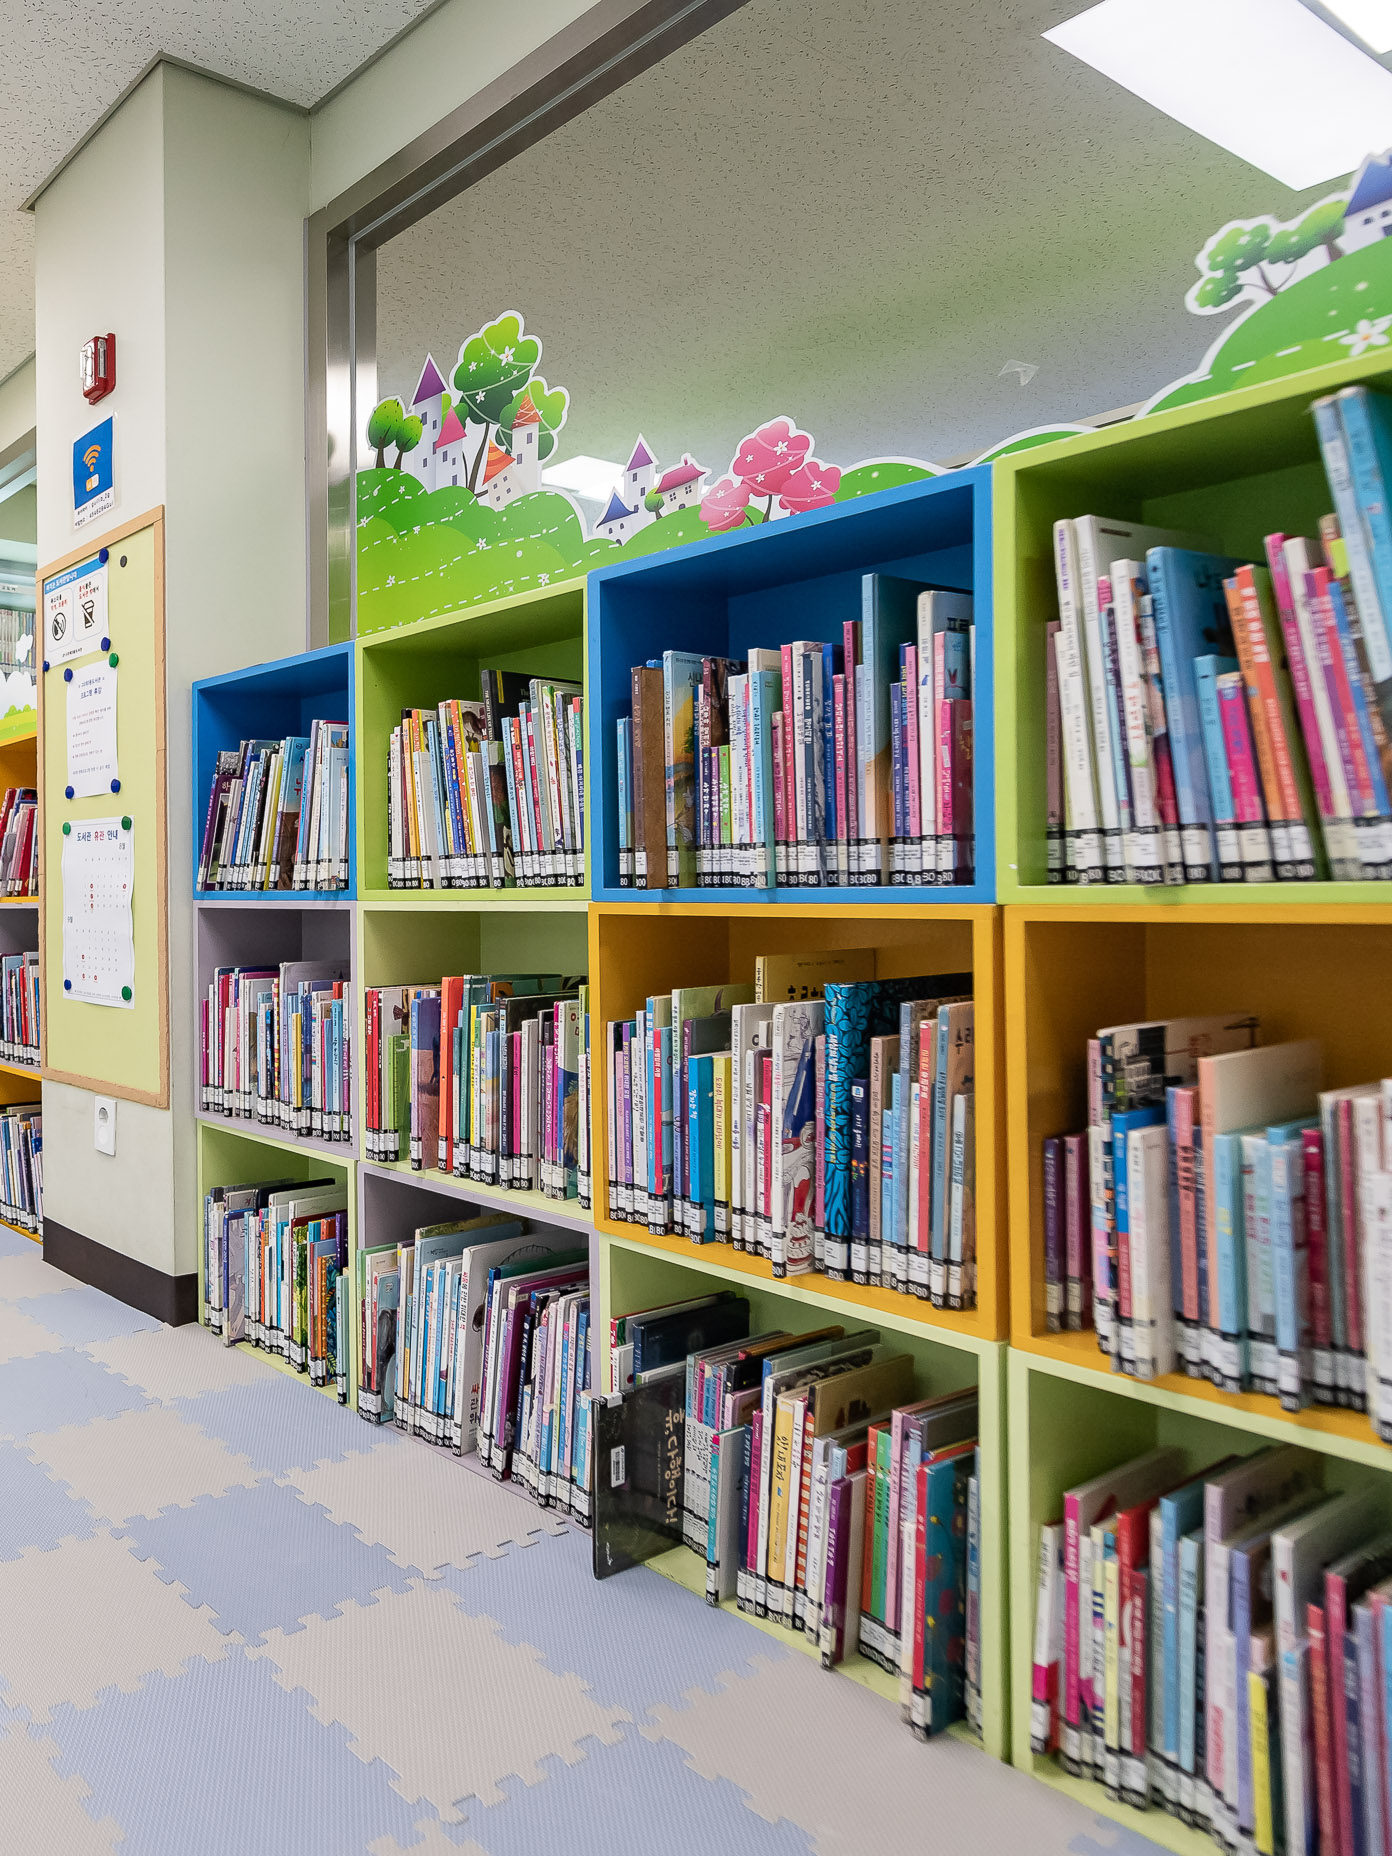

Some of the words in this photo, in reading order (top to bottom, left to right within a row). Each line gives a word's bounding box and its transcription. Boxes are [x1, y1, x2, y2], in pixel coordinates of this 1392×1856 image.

[77, 832, 92, 842] 도서관
[94, 831, 105, 842] 휴관
[107, 829, 119, 840] 안내
[665, 1408, 685, 1437] 휴,
[665, 1436, 683, 1524] 다행이다!
[775, 1462, 787, 1481] 모자
